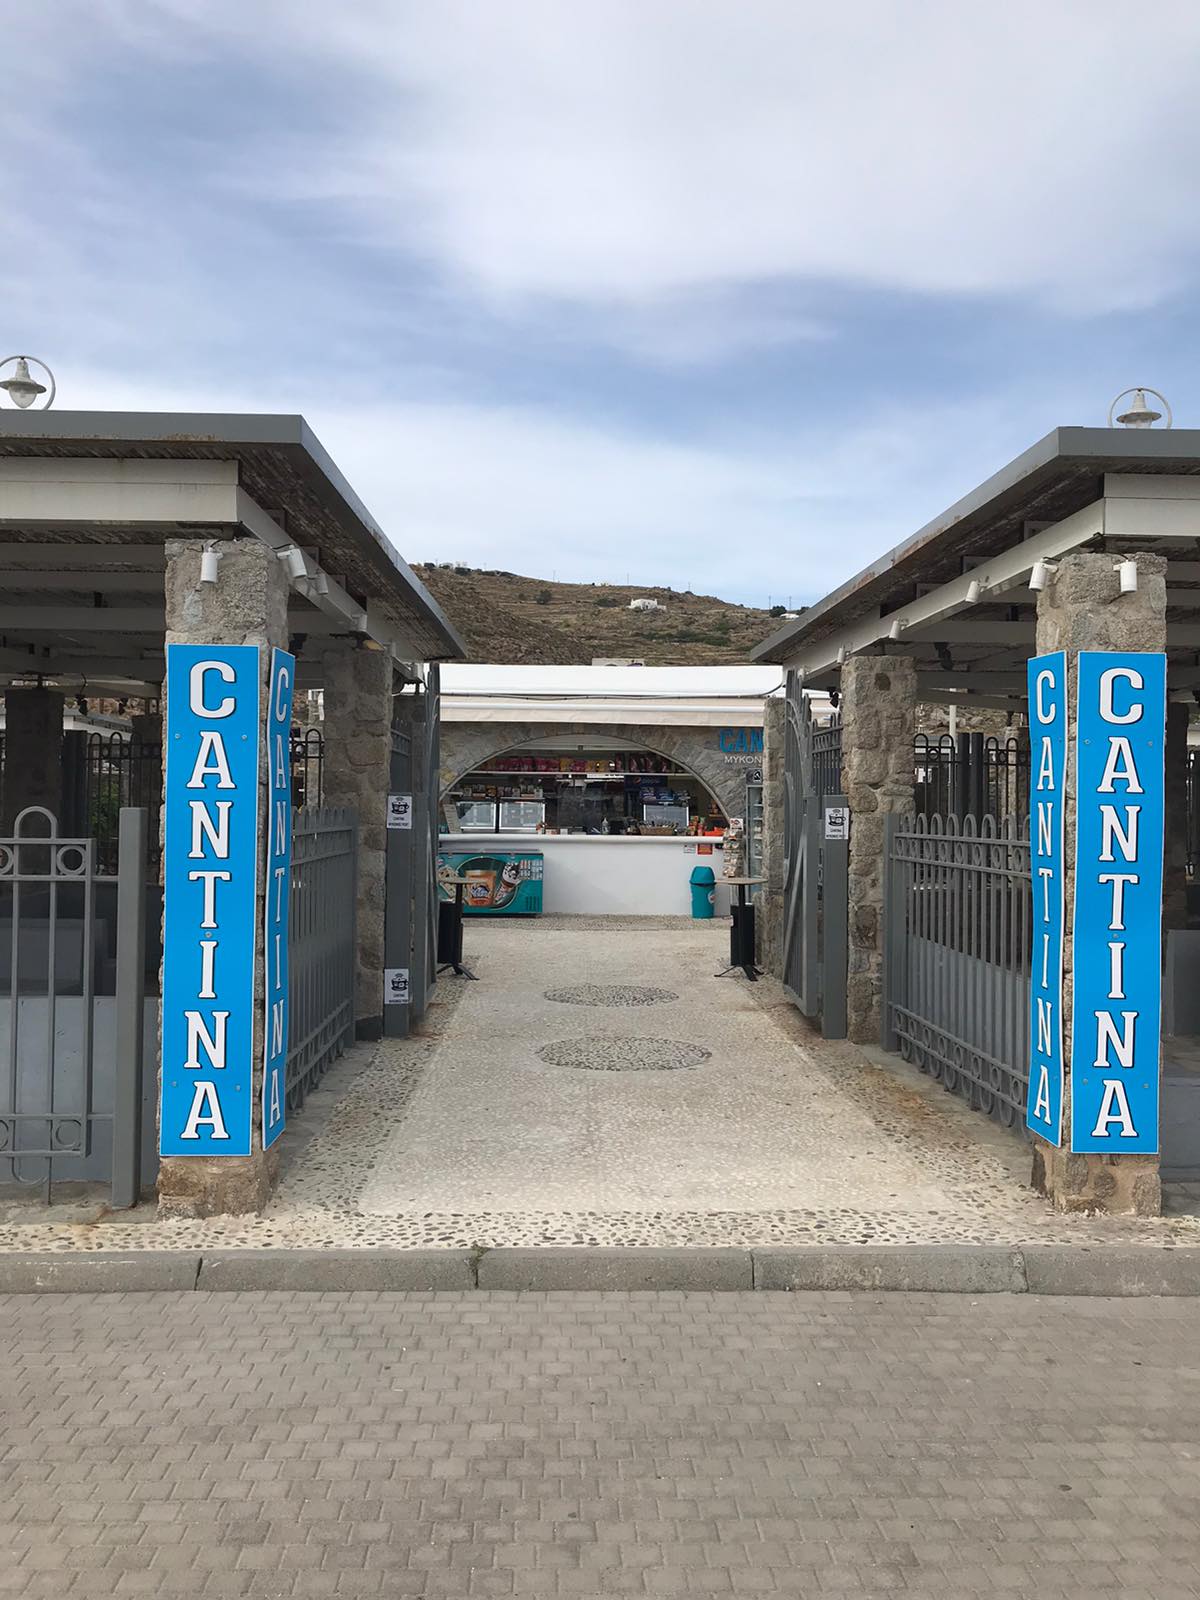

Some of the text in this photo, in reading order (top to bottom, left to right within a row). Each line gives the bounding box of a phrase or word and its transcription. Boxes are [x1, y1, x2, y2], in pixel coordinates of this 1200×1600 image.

[180, 660, 237, 1140] CANTINA
[268, 667, 290, 1129] CANTINA
[1033, 669, 1056, 1126] CANTINA
[1091, 668, 1145, 1138] CANTINA
